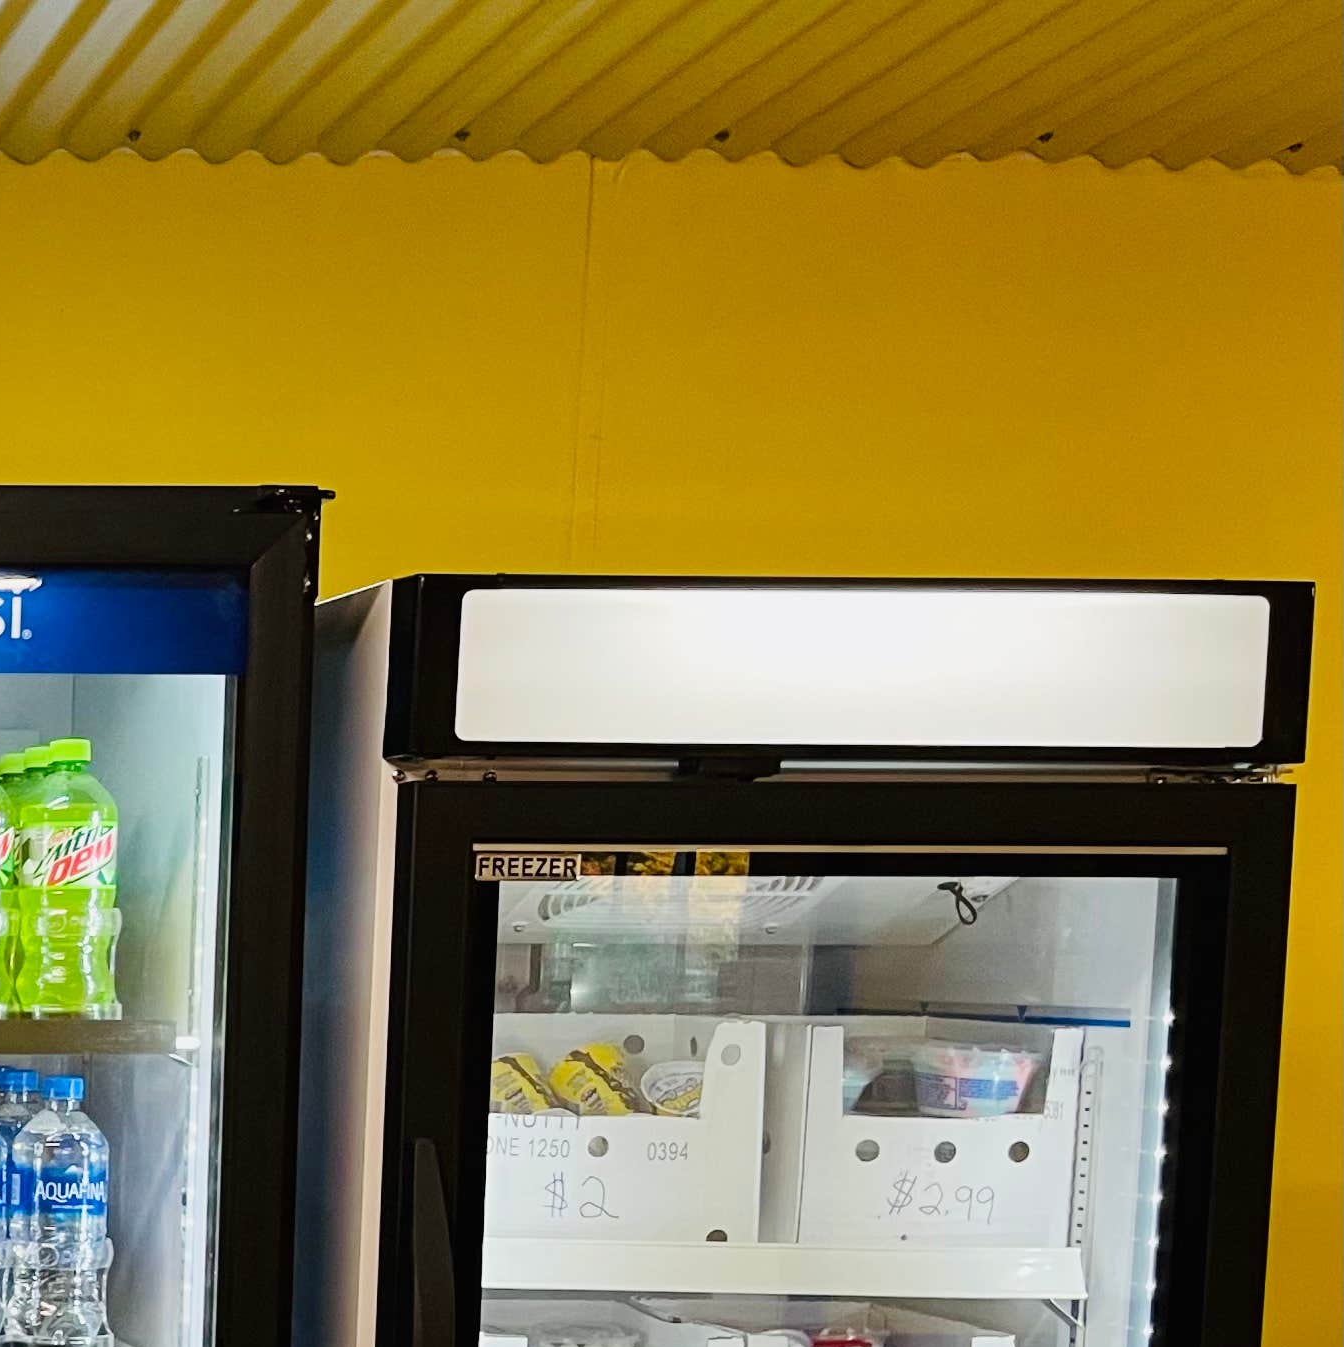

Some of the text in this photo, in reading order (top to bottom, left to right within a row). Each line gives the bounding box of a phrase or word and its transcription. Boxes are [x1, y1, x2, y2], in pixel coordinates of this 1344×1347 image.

[478, 856, 577, 878] FREEZER
[528, 1138, 571, 1159] 1250
[647, 1142, 689, 1161] 0394
[34, 1180, 105, 1203] AQUAFINA
[542, 1171, 620, 1219] $2
[886, 1169, 995, 1225] $2.99
